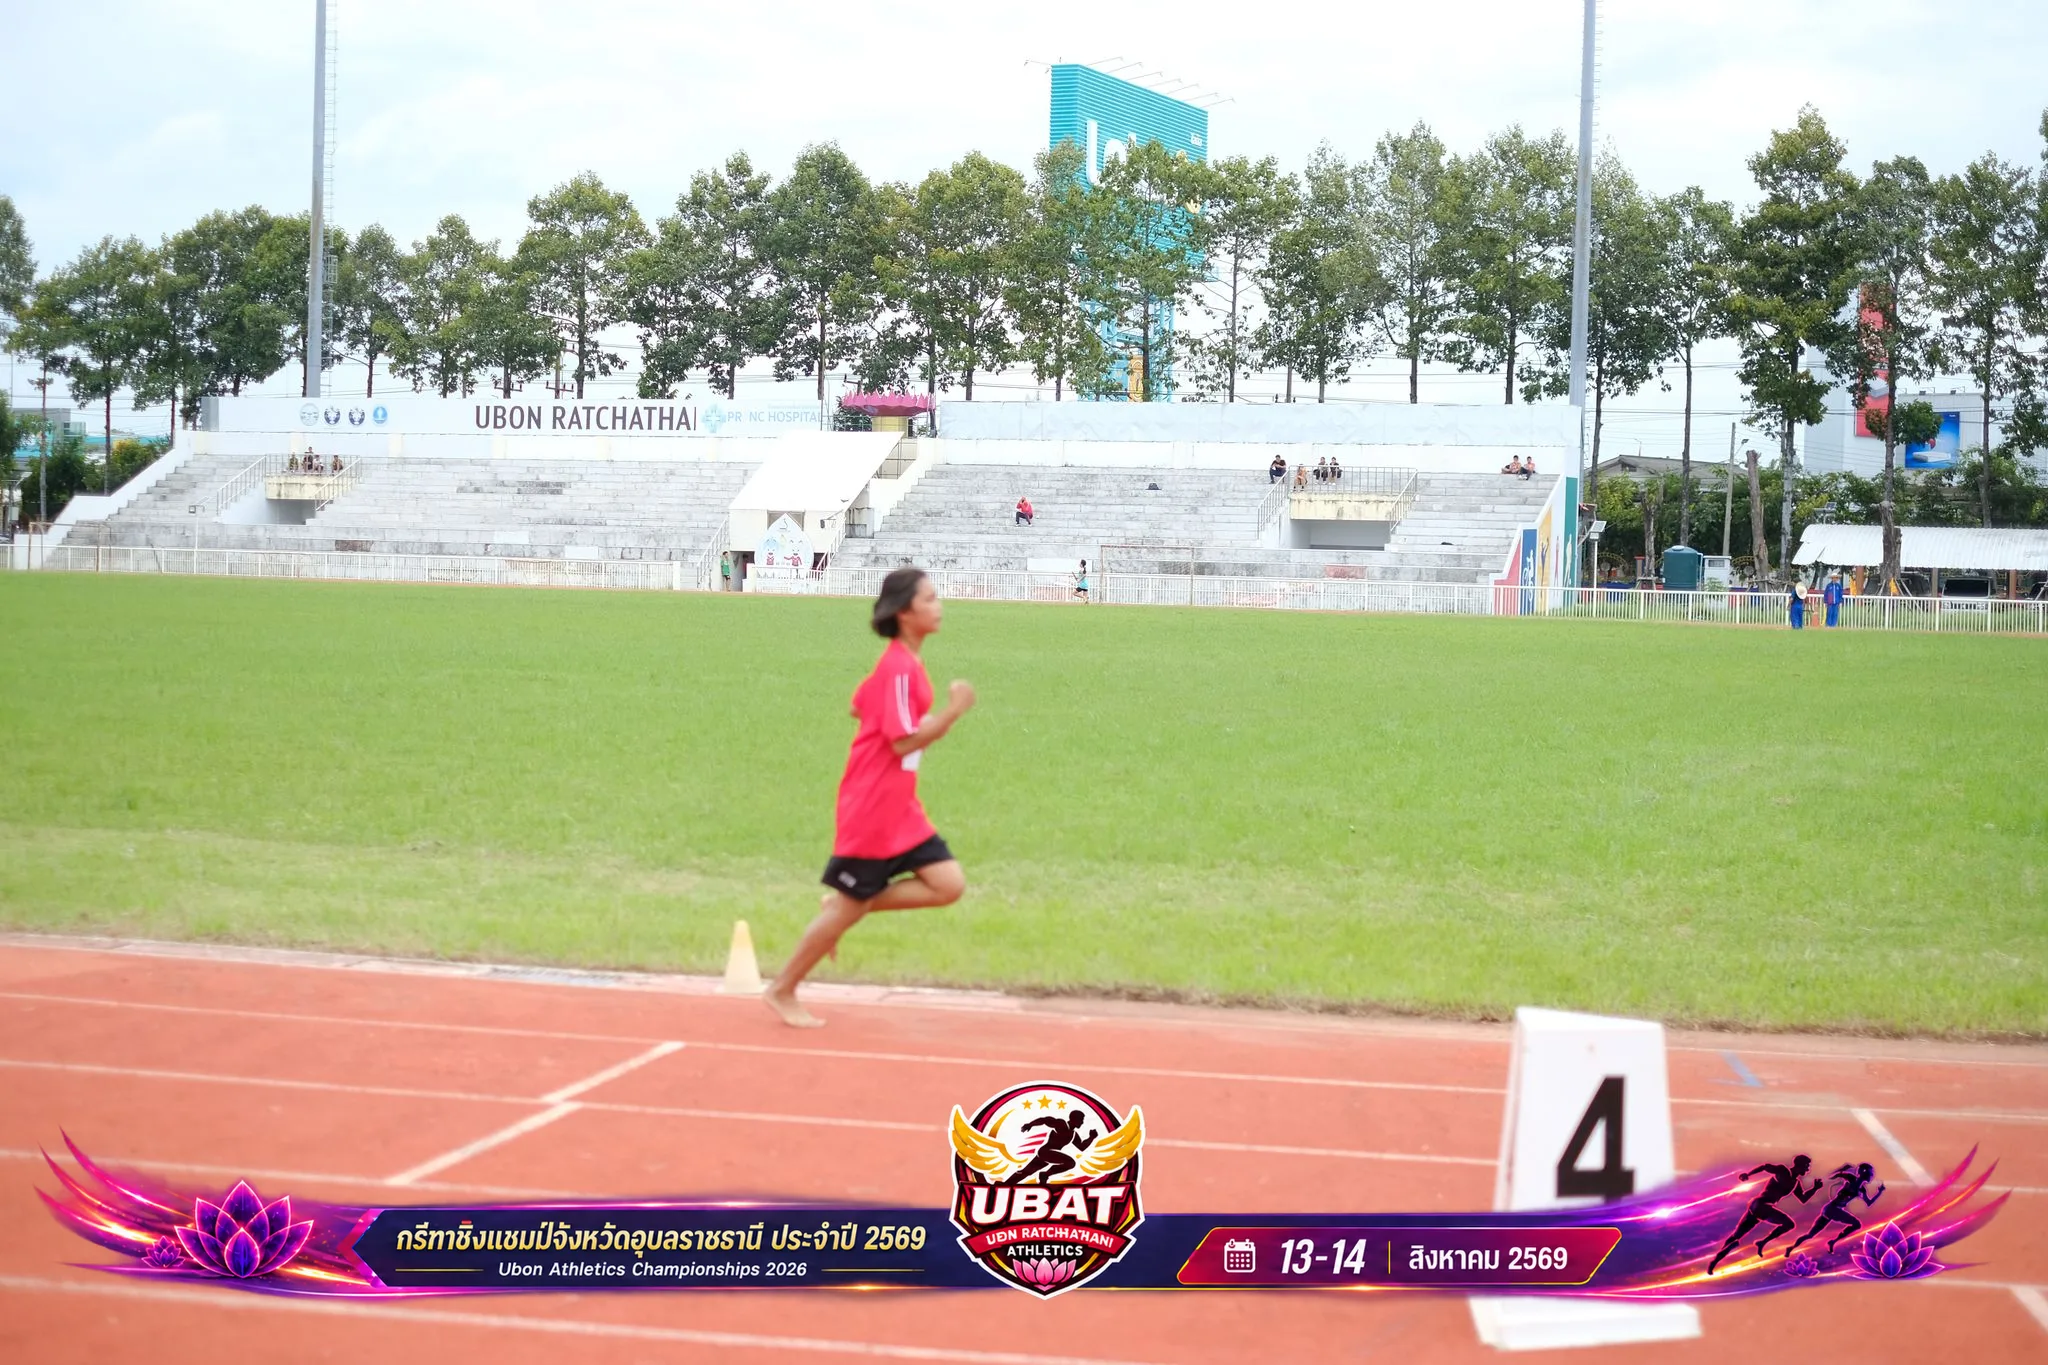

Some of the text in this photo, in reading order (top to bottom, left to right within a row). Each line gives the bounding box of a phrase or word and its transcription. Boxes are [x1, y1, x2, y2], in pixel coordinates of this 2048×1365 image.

[476, 406, 697, 431] UBON RATCHATHA
[768, 411, 823, 422] HOSPITAL
[1556, 1075, 1634, 1204] 4
